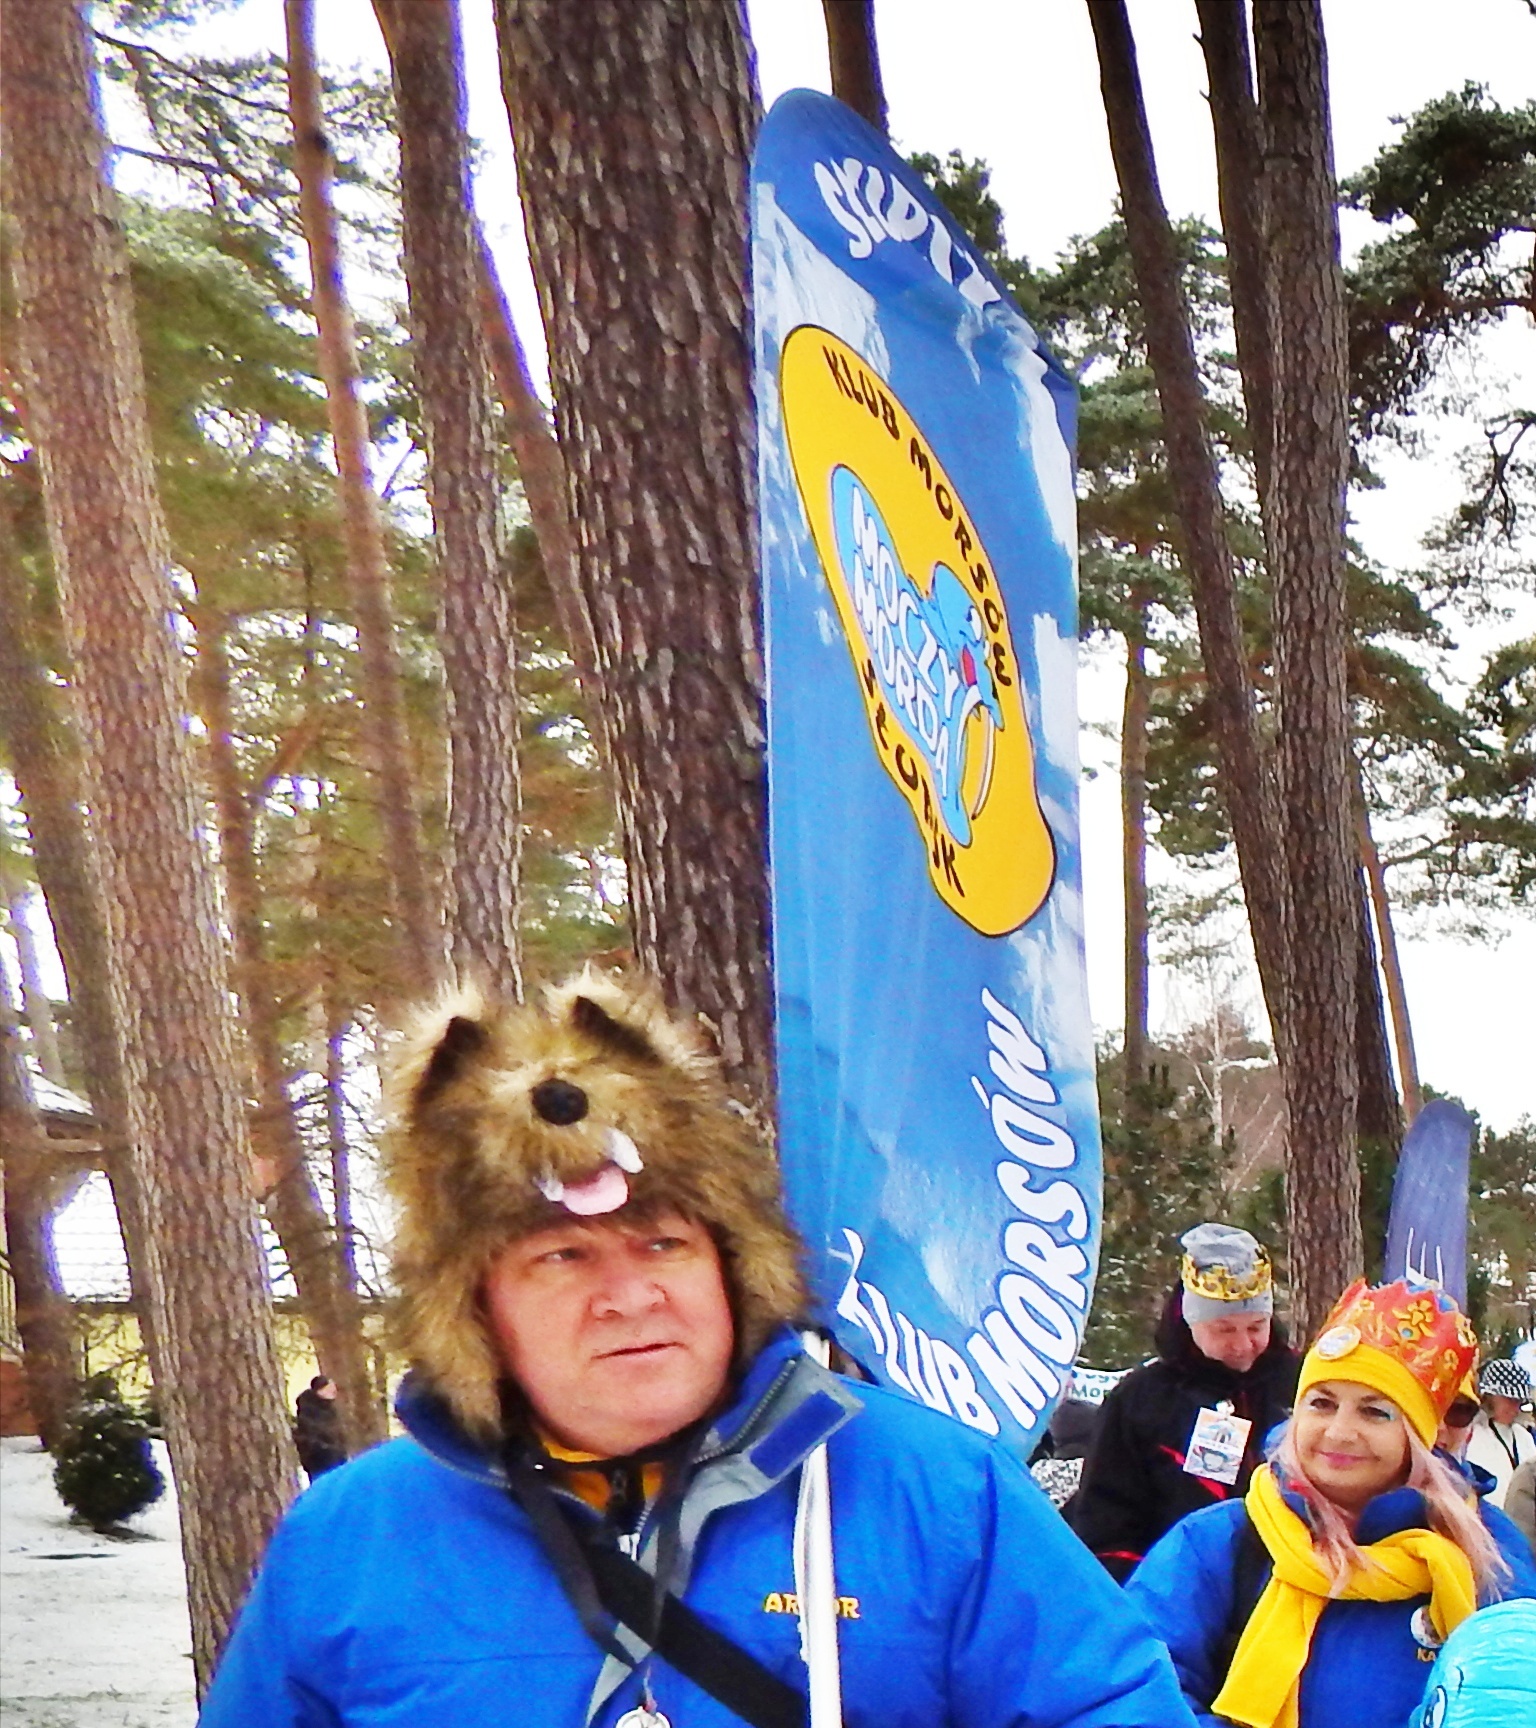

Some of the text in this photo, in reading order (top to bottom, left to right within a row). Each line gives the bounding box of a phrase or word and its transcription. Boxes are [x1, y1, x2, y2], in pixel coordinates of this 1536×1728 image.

[823, 345, 1013, 688] KLUB MORSÓW
[851, 483, 960, 720] MOCZY
[853, 550, 950, 799] MORDA
[966, 987, 1089, 1430] MORSÓW
[763, 1592, 861, 1619] ARR
[1417, 1647, 1437, 1662] KA
